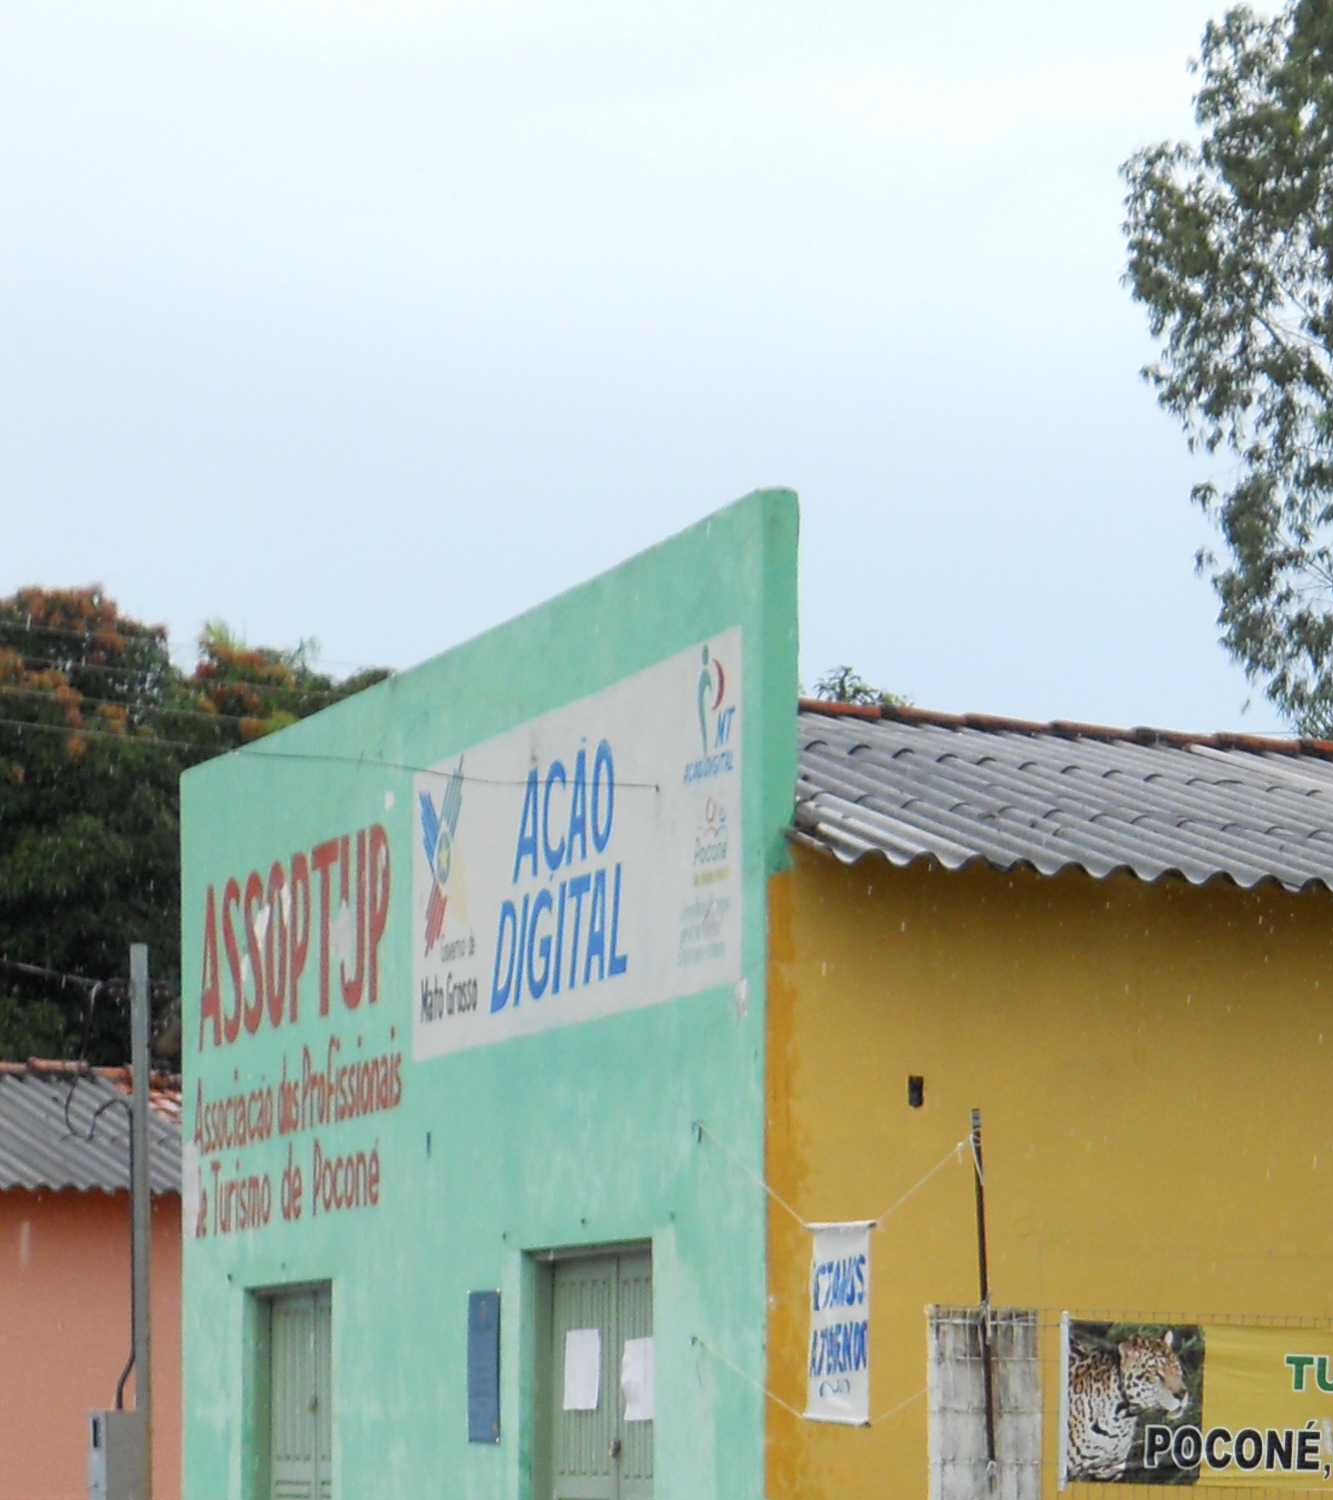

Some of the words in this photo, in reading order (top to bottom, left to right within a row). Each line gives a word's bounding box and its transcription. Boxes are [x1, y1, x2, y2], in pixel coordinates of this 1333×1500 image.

[511, 735, 615, 885] AÇÃO
[198, 822, 391, 1053] ASSOPTUP
[420, 973, 444, 1024] Mato
[445, 971, 478, 1016] Grosso
[489, 862, 628, 1015] DIGITAL
[302, 1025, 403, 1131] Profissionais
[210, 1156, 272, 1237] Turismo
[281, 1140, 302, 1222] de
[313, 1136, 380, 1217] Poconé
